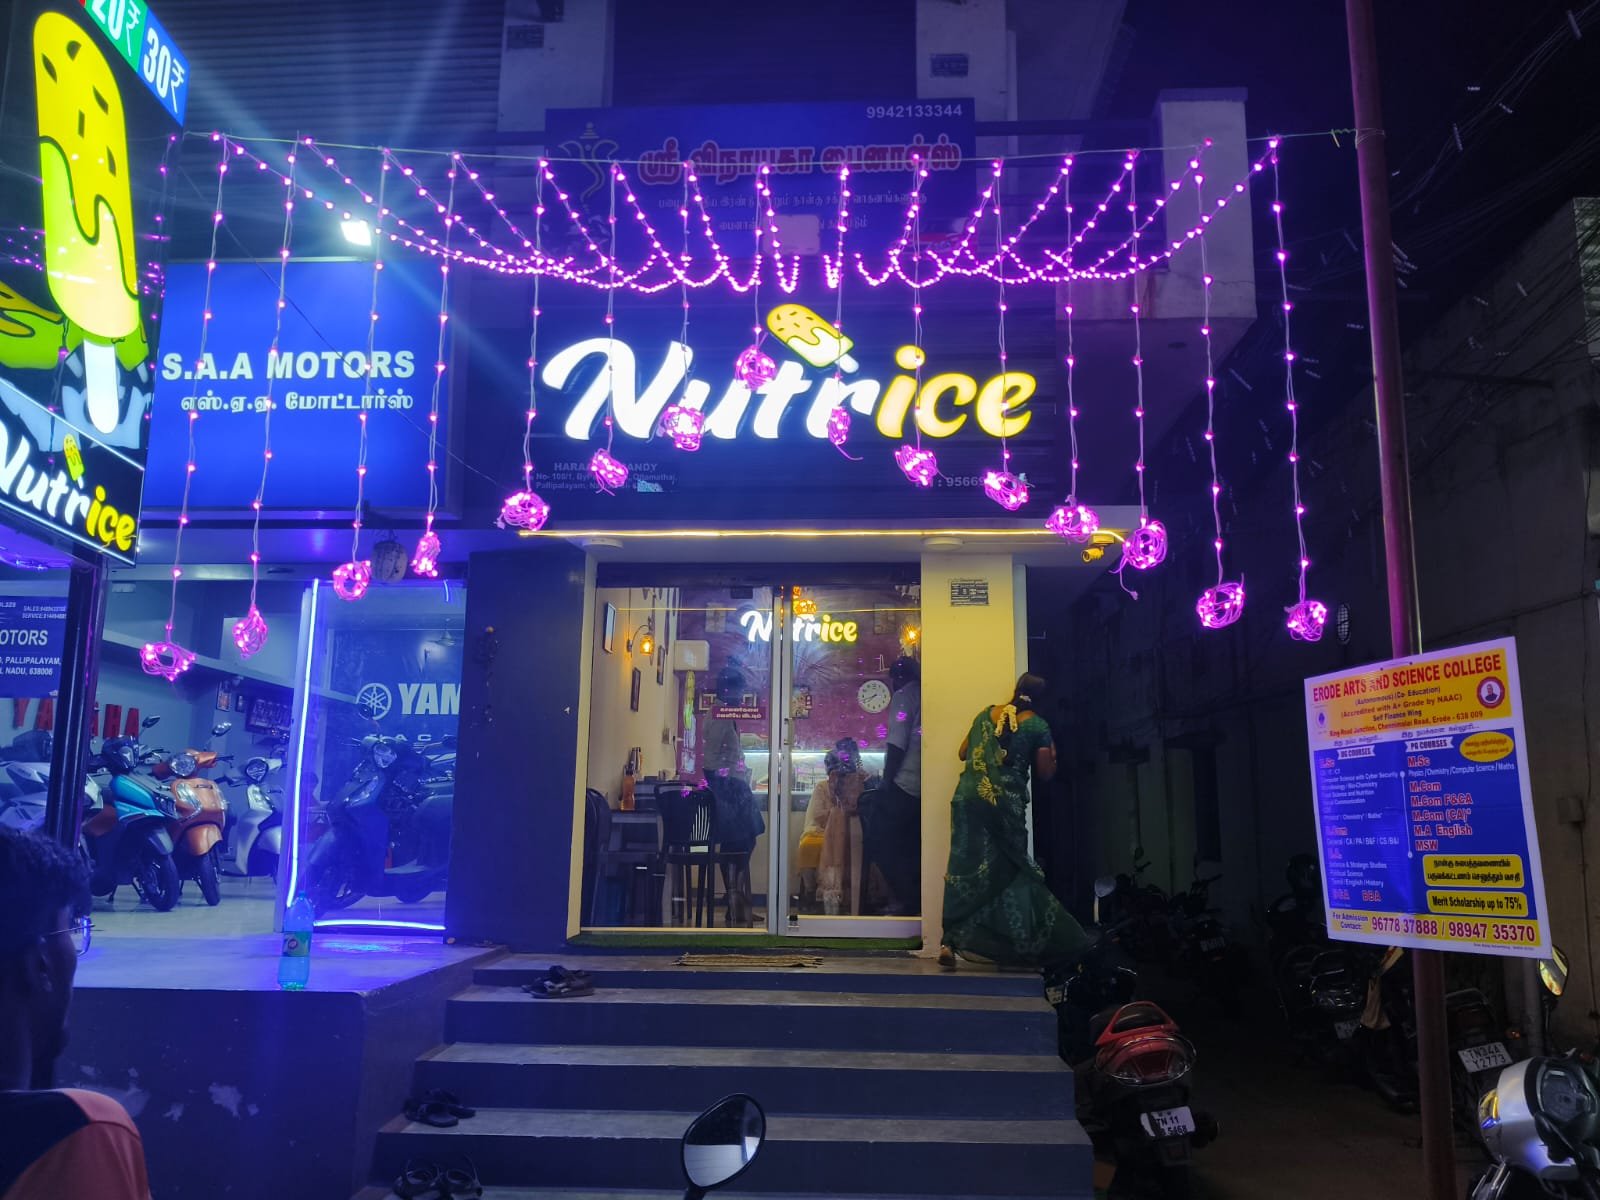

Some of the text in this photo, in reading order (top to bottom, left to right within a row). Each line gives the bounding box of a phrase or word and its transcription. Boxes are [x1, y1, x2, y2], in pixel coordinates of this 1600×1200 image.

[143, 27, 185, 114] 30₹
[866, 103, 963, 119] 9942133344
[162, 350, 416, 381] S.A.A MOTORS
[541, 337, 1037, 440] Nutrice
[740, 609, 857, 643] Ntrice
[1313, 683, 1341, 702] ERODE
[1344, 678, 1367, 697] ARTS
[1393, 664, 1441, 688] SCIENCE
[1443, 654, 1502, 679] COLLEGE
[1403, 699, 1425, 710] Grade
[1420, 739, 1447, 750] COURSES
[1436, 822, 1473, 838] English
[1415, 839, 1439, 852] MSW
[1450, 896, 1486, 911] Scholarship
[1371, 916, 1400, 931] 96778
[1403, 919, 1438, 936] 37888
[1449, 922, 1487, 939] 98947
[1493, 924, 1535, 942] 35370
